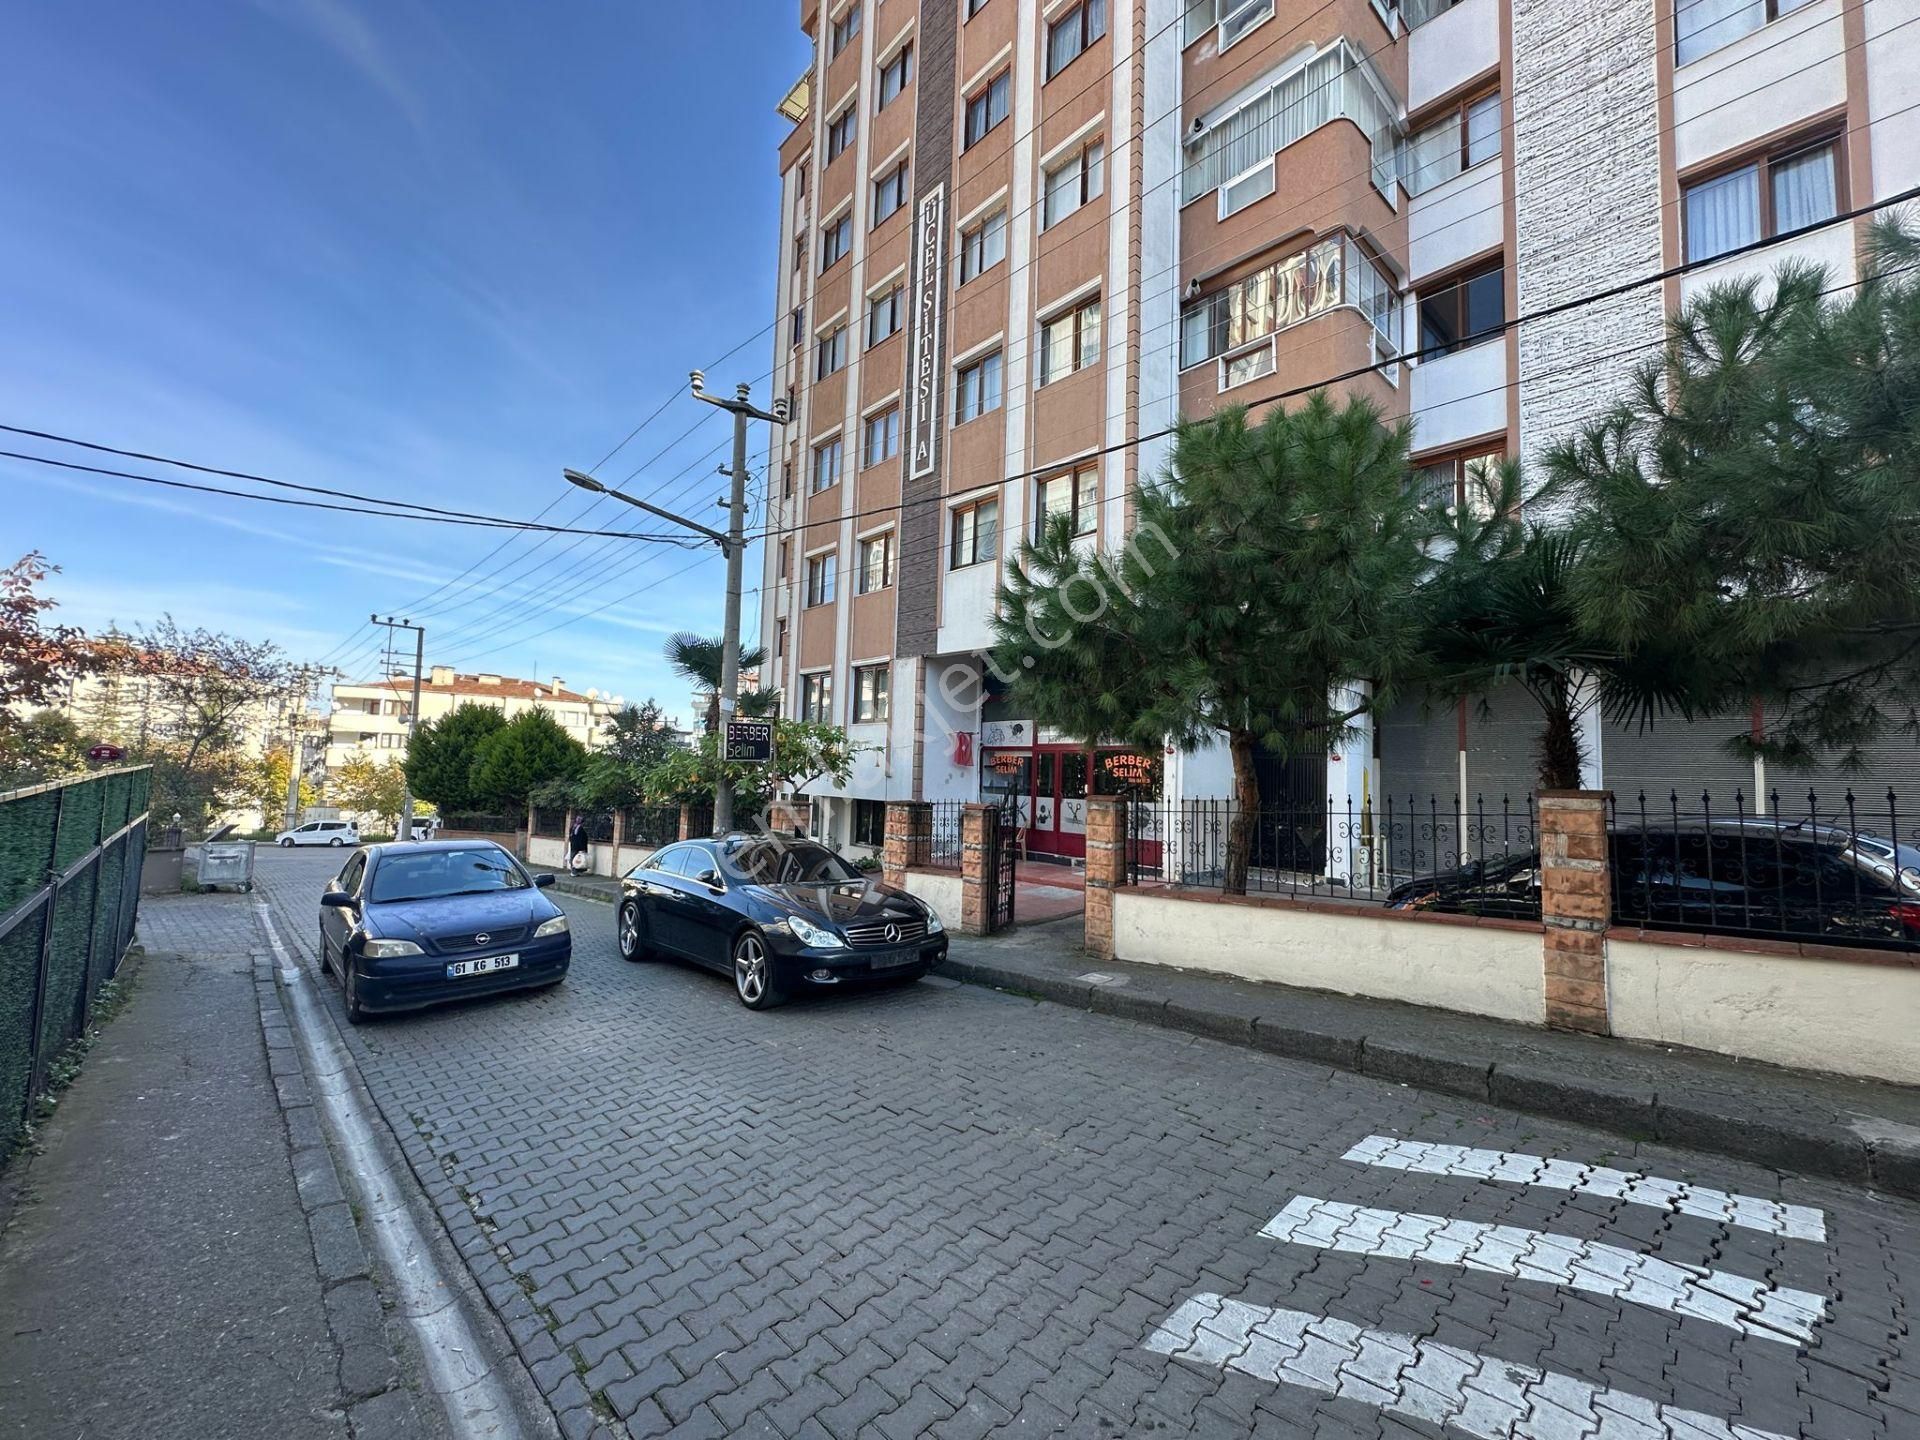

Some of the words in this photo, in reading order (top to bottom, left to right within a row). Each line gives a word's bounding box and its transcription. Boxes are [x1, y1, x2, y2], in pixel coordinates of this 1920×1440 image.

[919, 290, 933, 422] SİTESİ
[916, 440, 928, 461] A
[728, 725, 769, 741] BERBER
[727, 741, 755, 758] Selim
[990, 754, 1024, 768] BERBER
[1104, 754, 1151, 769] BERBER
[1112, 765, 1143, 778] SELİM
[455, 963, 466, 975] 61
[473, 960, 487, 972] KG
[494, 956, 511, 969] 513
